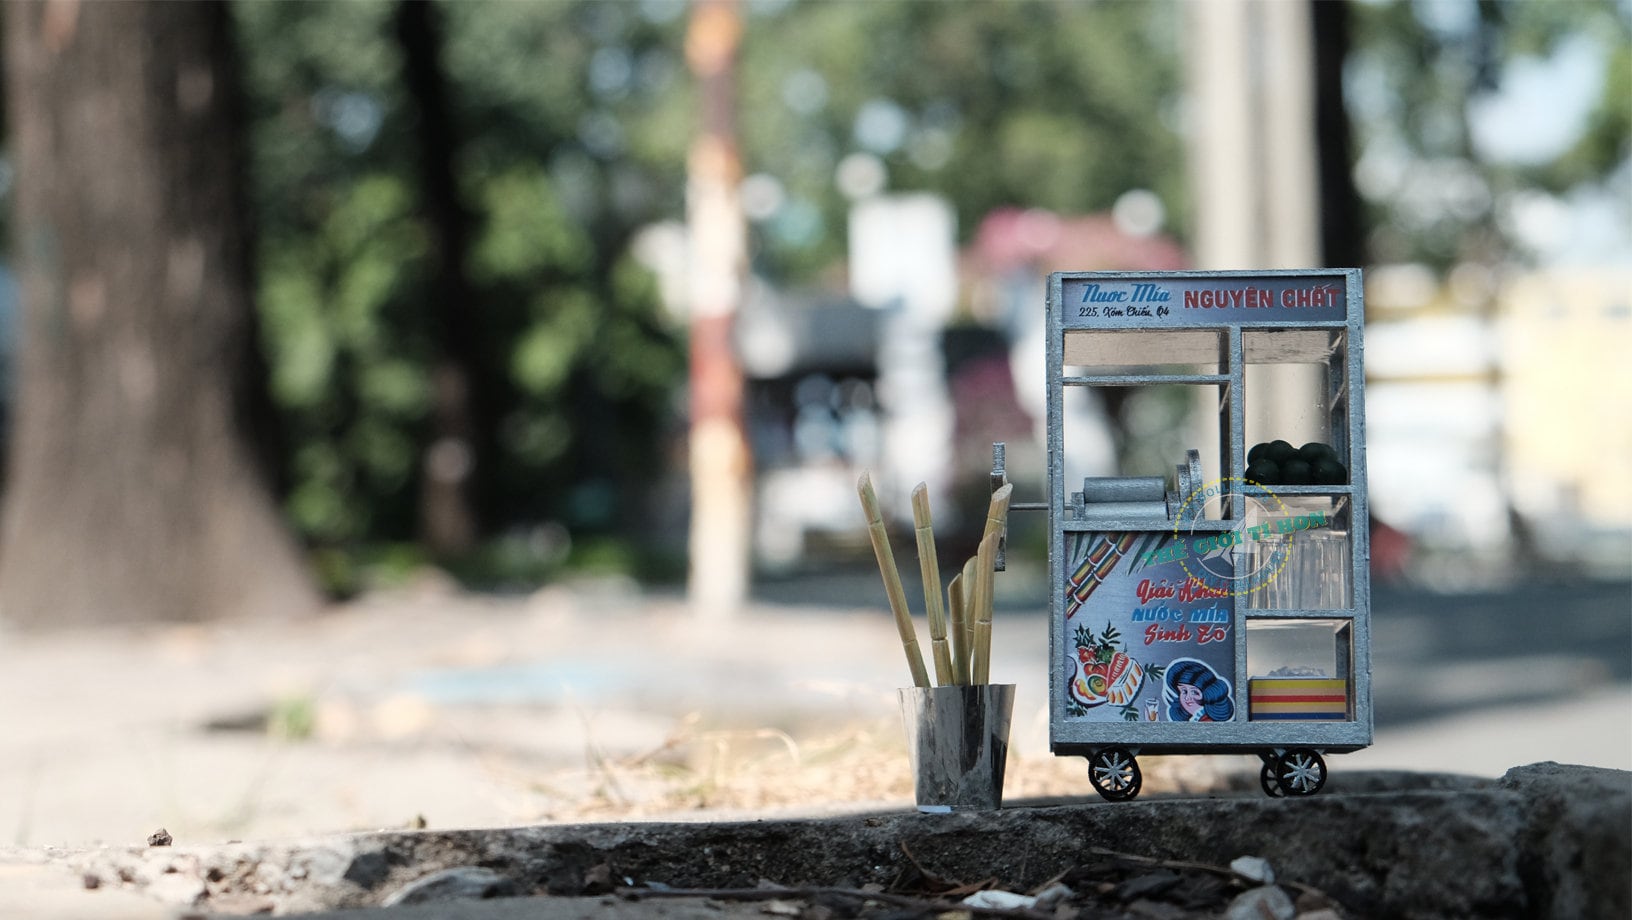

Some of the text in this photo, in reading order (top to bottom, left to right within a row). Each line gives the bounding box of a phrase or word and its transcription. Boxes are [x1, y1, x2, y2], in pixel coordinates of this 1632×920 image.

[1184, 283, 1341, 309] NGUYÊN CHẤT
[1144, 623, 1192, 646] Sinh
